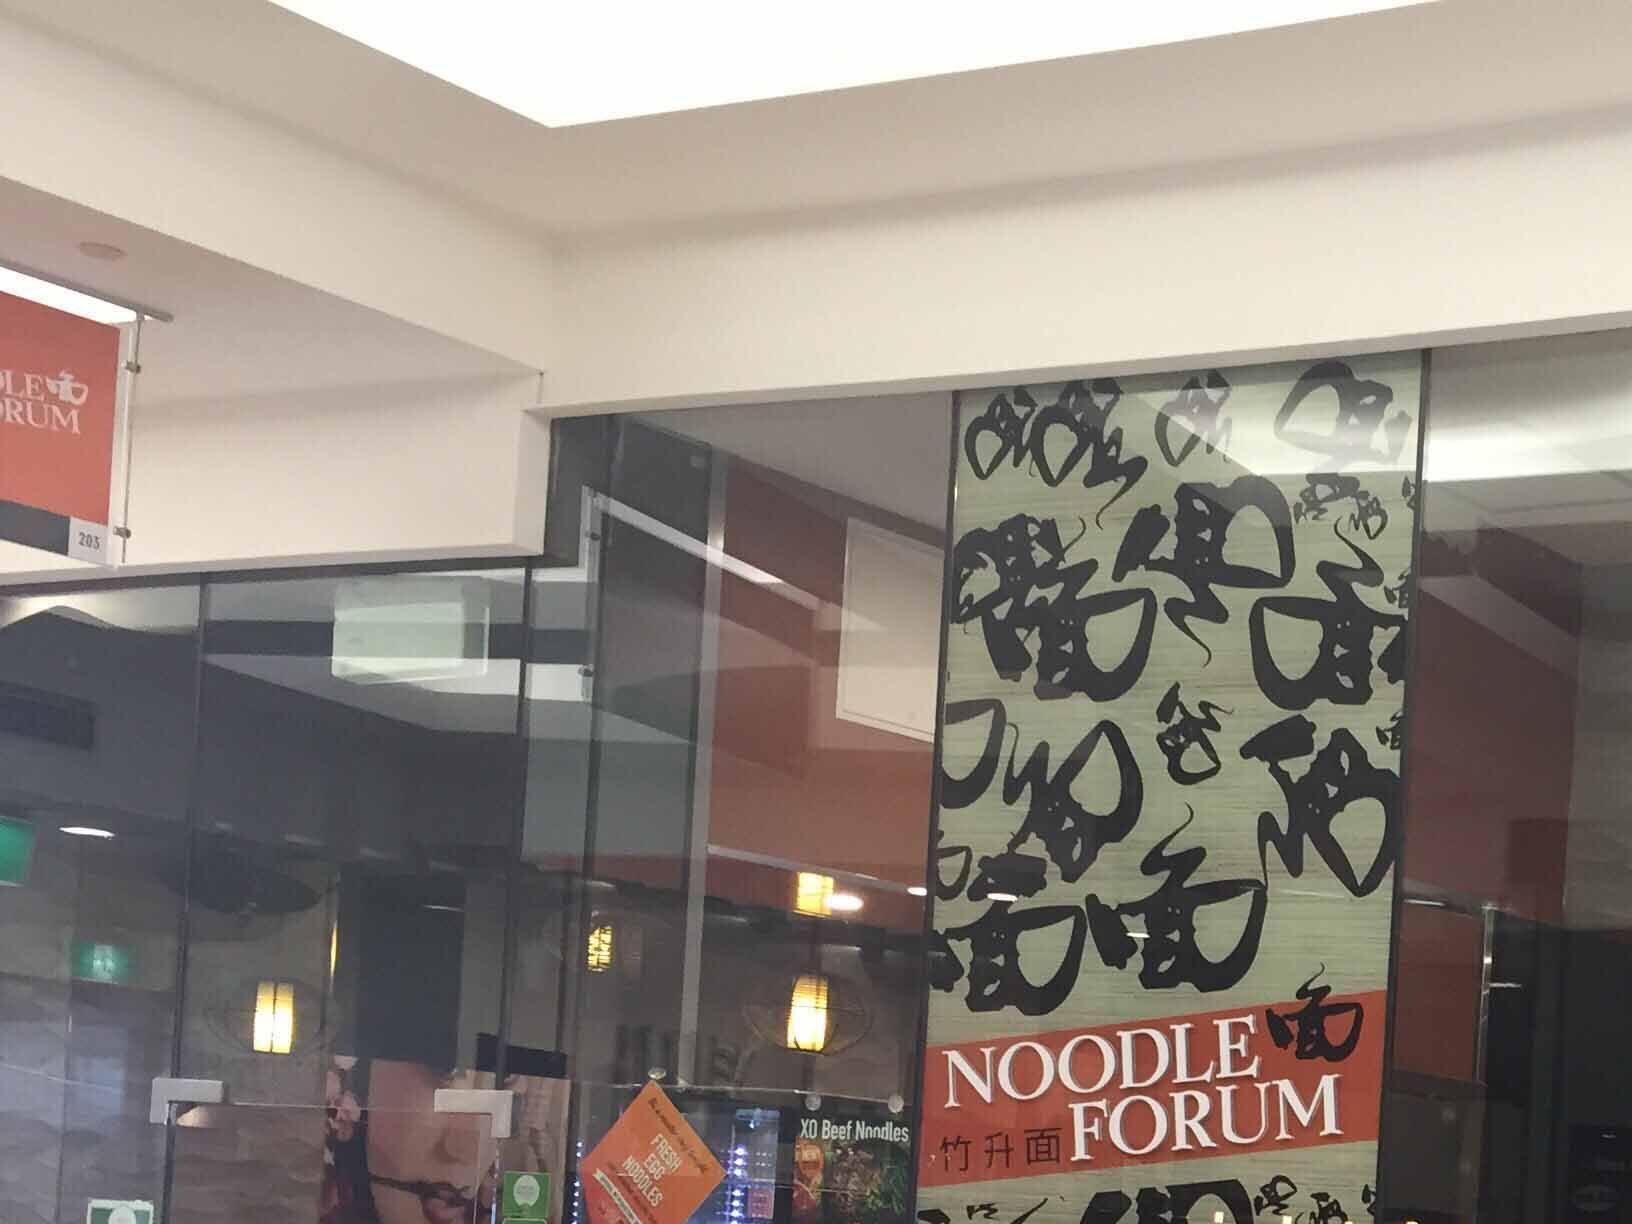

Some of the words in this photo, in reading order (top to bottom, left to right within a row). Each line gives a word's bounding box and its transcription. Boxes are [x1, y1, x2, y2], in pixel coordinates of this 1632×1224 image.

[0, 398, 80, 434] RUM
[943, 1013, 1262, 1109] NOODLE
[800, 1118, 818, 1139] XO
[821, 1119, 852, 1140] Beef
[855, 1120, 910, 1142] Noodles
[1068, 1073, 1344, 1162] FORUM
[644, 1153, 666, 1181] EGG
[650, 1133, 683, 1173] FRESH
[940, 1127, 1063, 1172] 竹升面
[622, 1155, 664, 1207] NOODLES
